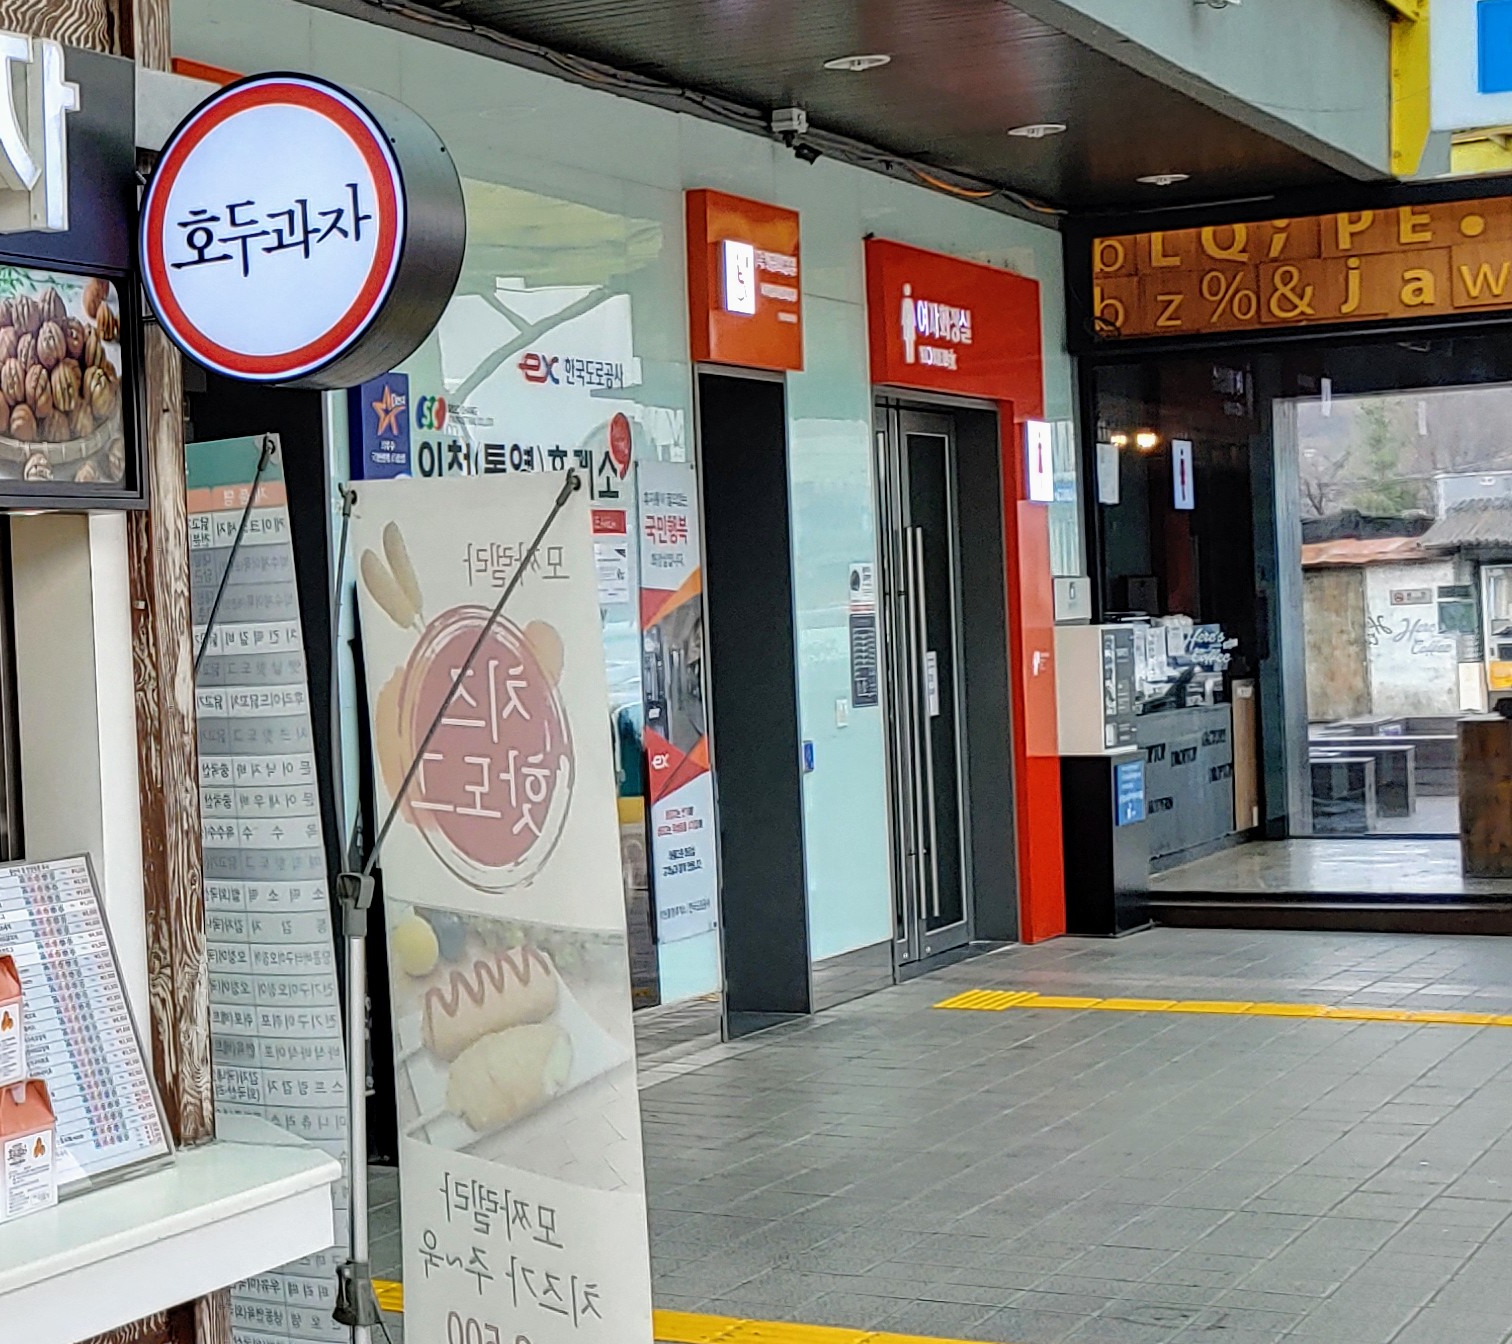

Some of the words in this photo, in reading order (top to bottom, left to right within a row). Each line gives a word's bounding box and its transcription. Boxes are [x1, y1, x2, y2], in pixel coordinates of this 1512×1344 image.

[171, 182, 372, 279] 호두과자
[1336, 210, 1375, 250] P
[1399, 206, 1433, 244] E
[1202, 270, 1257, 323] %
[1269, 265, 1315, 320] &
[1340, 257, 1361, 314] j
[1400, 267, 1435, 306] a
[565, 356, 624, 389] 한국도로공사
[645, 514, 689, 546] 국민행복
